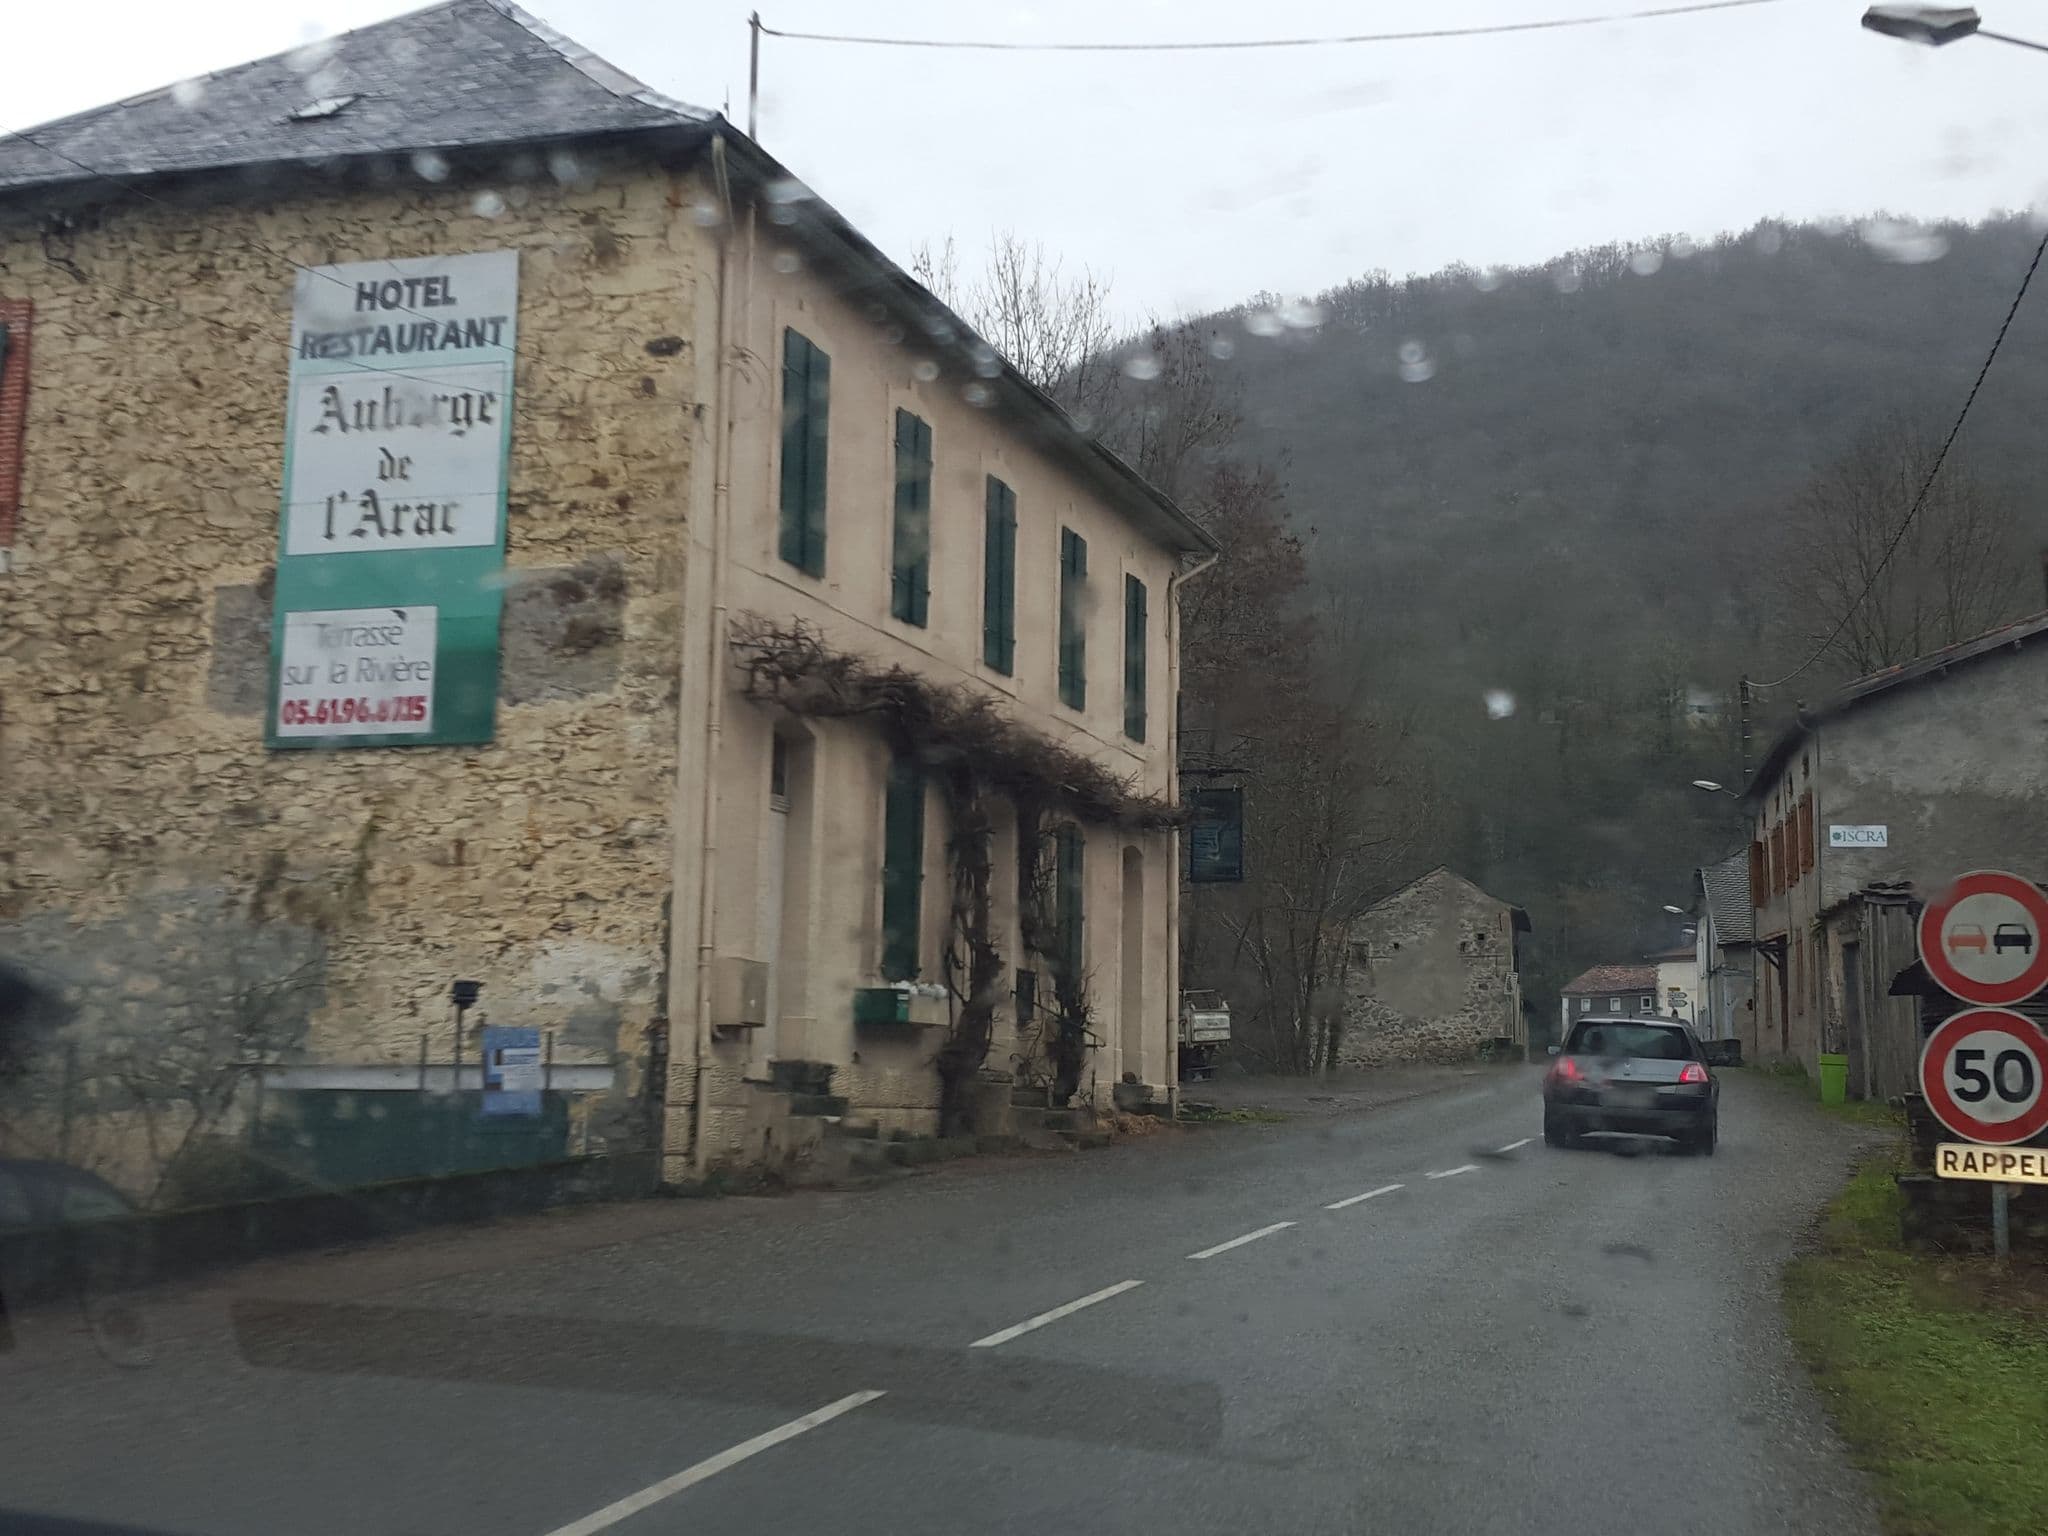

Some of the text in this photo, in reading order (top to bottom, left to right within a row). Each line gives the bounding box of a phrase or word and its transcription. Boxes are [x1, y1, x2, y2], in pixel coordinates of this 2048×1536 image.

[355, 275, 457, 312] HOTEL
[299, 316, 508, 360] RESTAURANT
[377, 446, 413, 481] de
[283, 656, 431, 686] sur la Rivière
[1842, 830, 1886, 843] ISCRA
[1953, 1049, 2034, 1103] 50
[1943, 1150, 2048, 1178] RAPPEL
